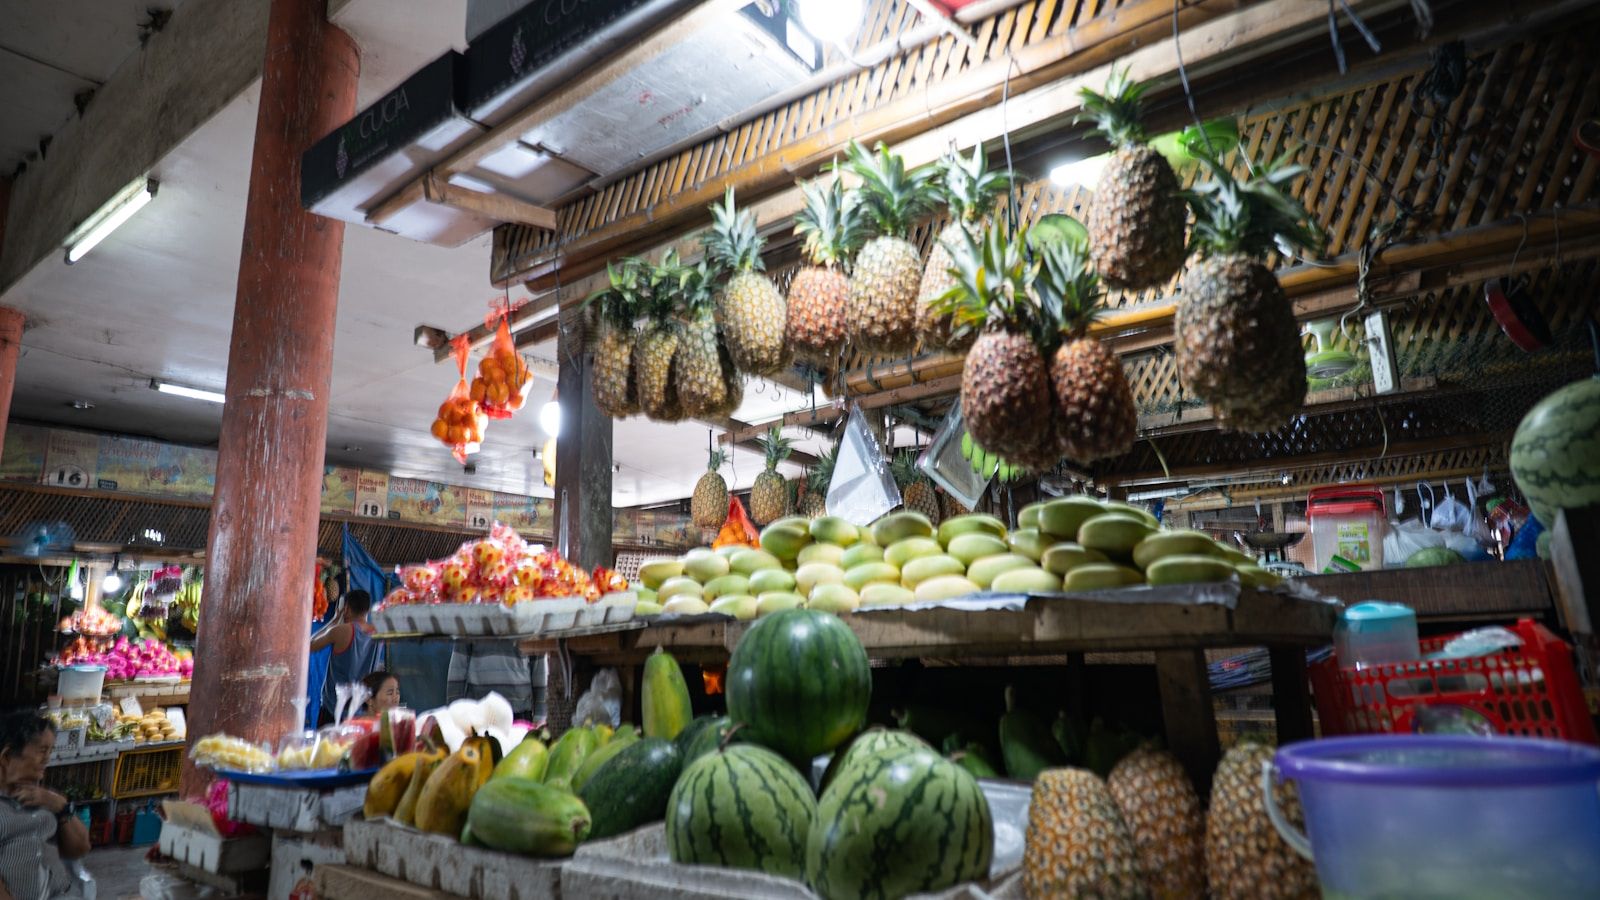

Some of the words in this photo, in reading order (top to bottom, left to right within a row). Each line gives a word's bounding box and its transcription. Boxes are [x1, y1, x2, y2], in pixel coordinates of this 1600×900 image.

[58, 468, 81, 485] 16
[364, 504, 378, 516] 18
[473, 516, 486, 527] 19
